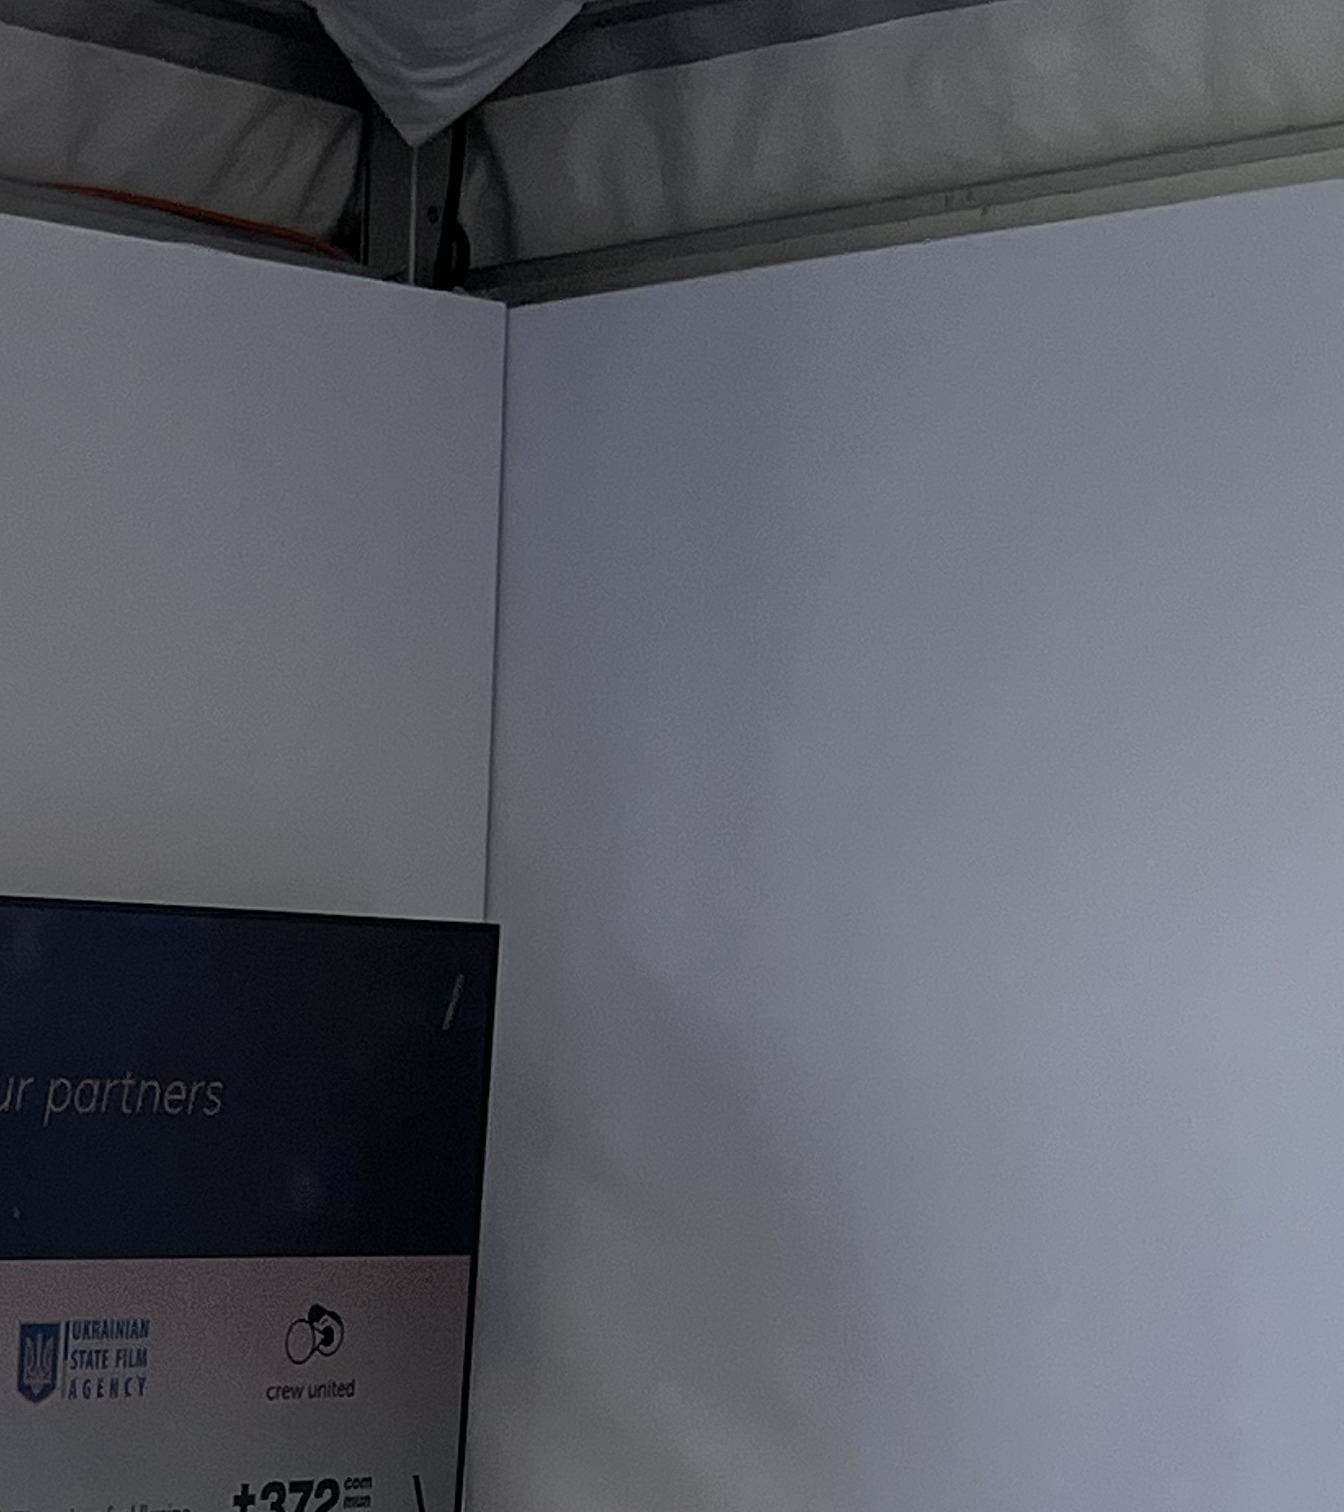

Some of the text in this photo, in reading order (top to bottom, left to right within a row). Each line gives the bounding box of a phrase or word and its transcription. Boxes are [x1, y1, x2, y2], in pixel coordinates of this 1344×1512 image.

[42, 1071, 224, 1128] partners
[70, 1318, 150, 1342] UKRAINIAN
[69, 1345, 148, 1371] STATE FILM
[67, 1376, 148, 1400] AGENCY
[266, 1378, 356, 1401] crew united
